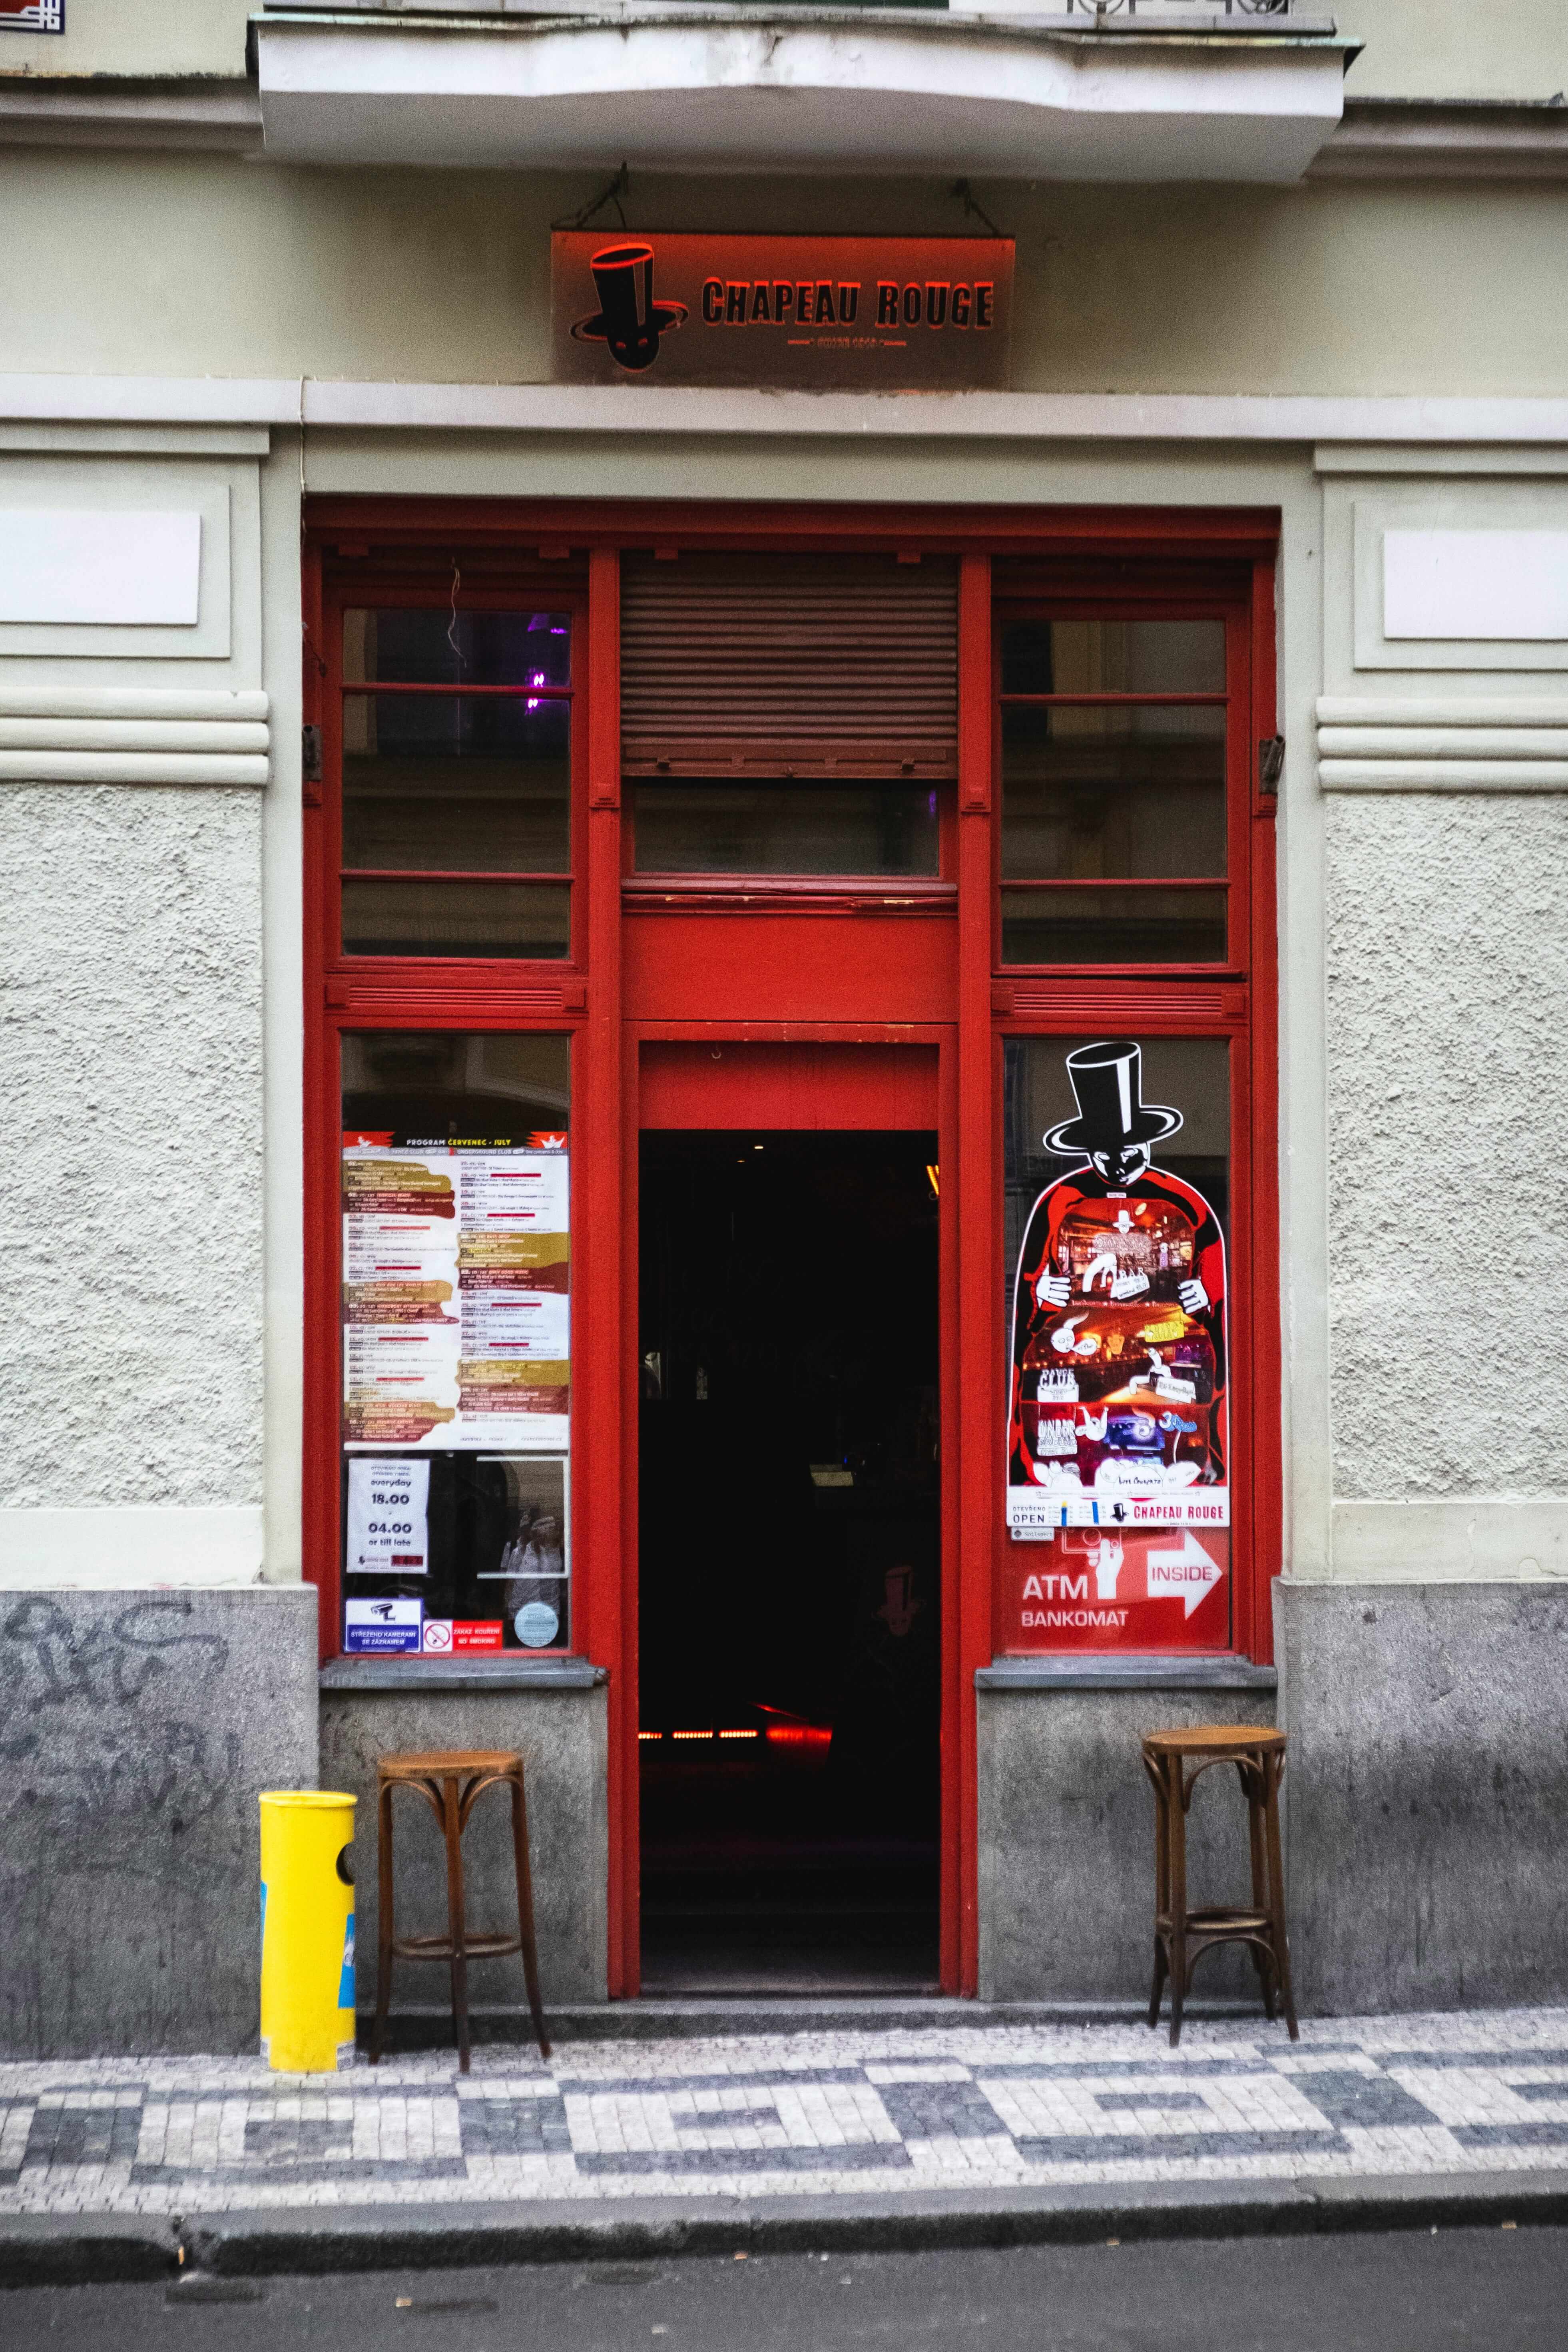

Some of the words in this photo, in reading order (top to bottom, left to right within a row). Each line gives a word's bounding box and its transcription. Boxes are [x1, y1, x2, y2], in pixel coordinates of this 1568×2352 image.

[701, 276, 861, 327] CHAPEAU
[875, 280, 995, 331] ROUGE
[1040, 1374, 1076, 1387] CLUB
[371, 1479, 411, 1487] everyday
[372, 1494, 409, 1505] 18.00
[1013, 1514, 1045, 1523] OPEN
[1134, 1506, 1182, 1519] CHAPEAU
[1188, 1506, 1224, 1520] ROUGE
[368, 1523, 412, 1533] 04.00
[1152, 1566, 1213, 1581] INSIDE
[1022, 1574, 1088, 1600] ATM
[1021, 1610, 1129, 1627] BANKOMAT
